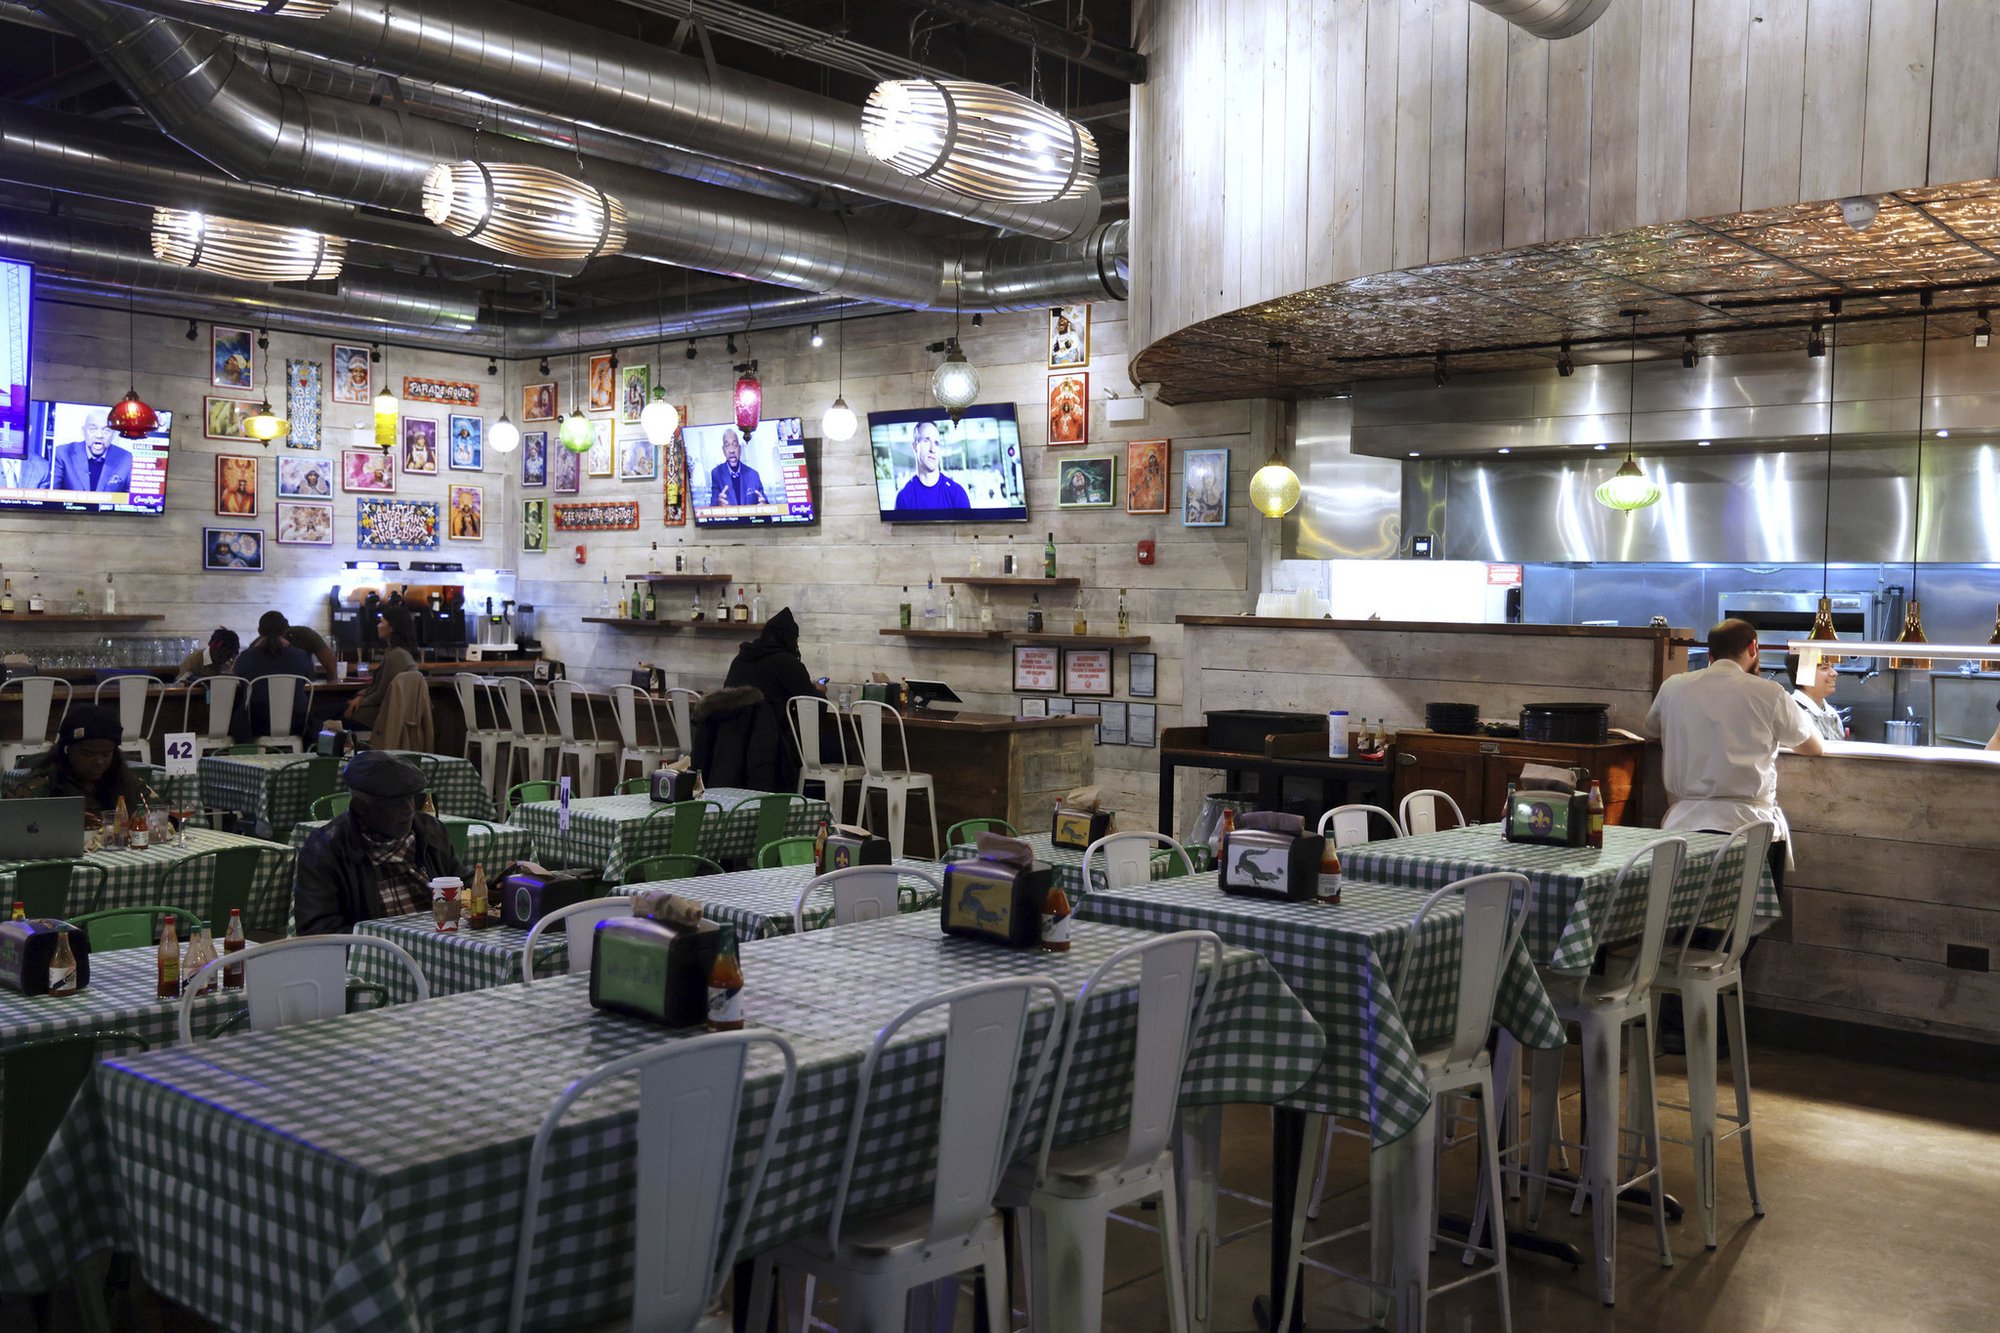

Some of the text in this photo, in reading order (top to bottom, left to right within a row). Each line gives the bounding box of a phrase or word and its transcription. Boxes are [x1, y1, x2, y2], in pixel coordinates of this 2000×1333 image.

[296, 387, 310, 398] BE
[410, 382, 471, 399] PARADE ROUTE
[292, 399, 317, 410] NICE
[299, 408, 310, 417] OR
[386, 503, 416, 514] LITTLE
[562, 511, 575, 521] SEE
[371, 520, 400, 536] NEVER
[167, 741, 193, 759] 42
